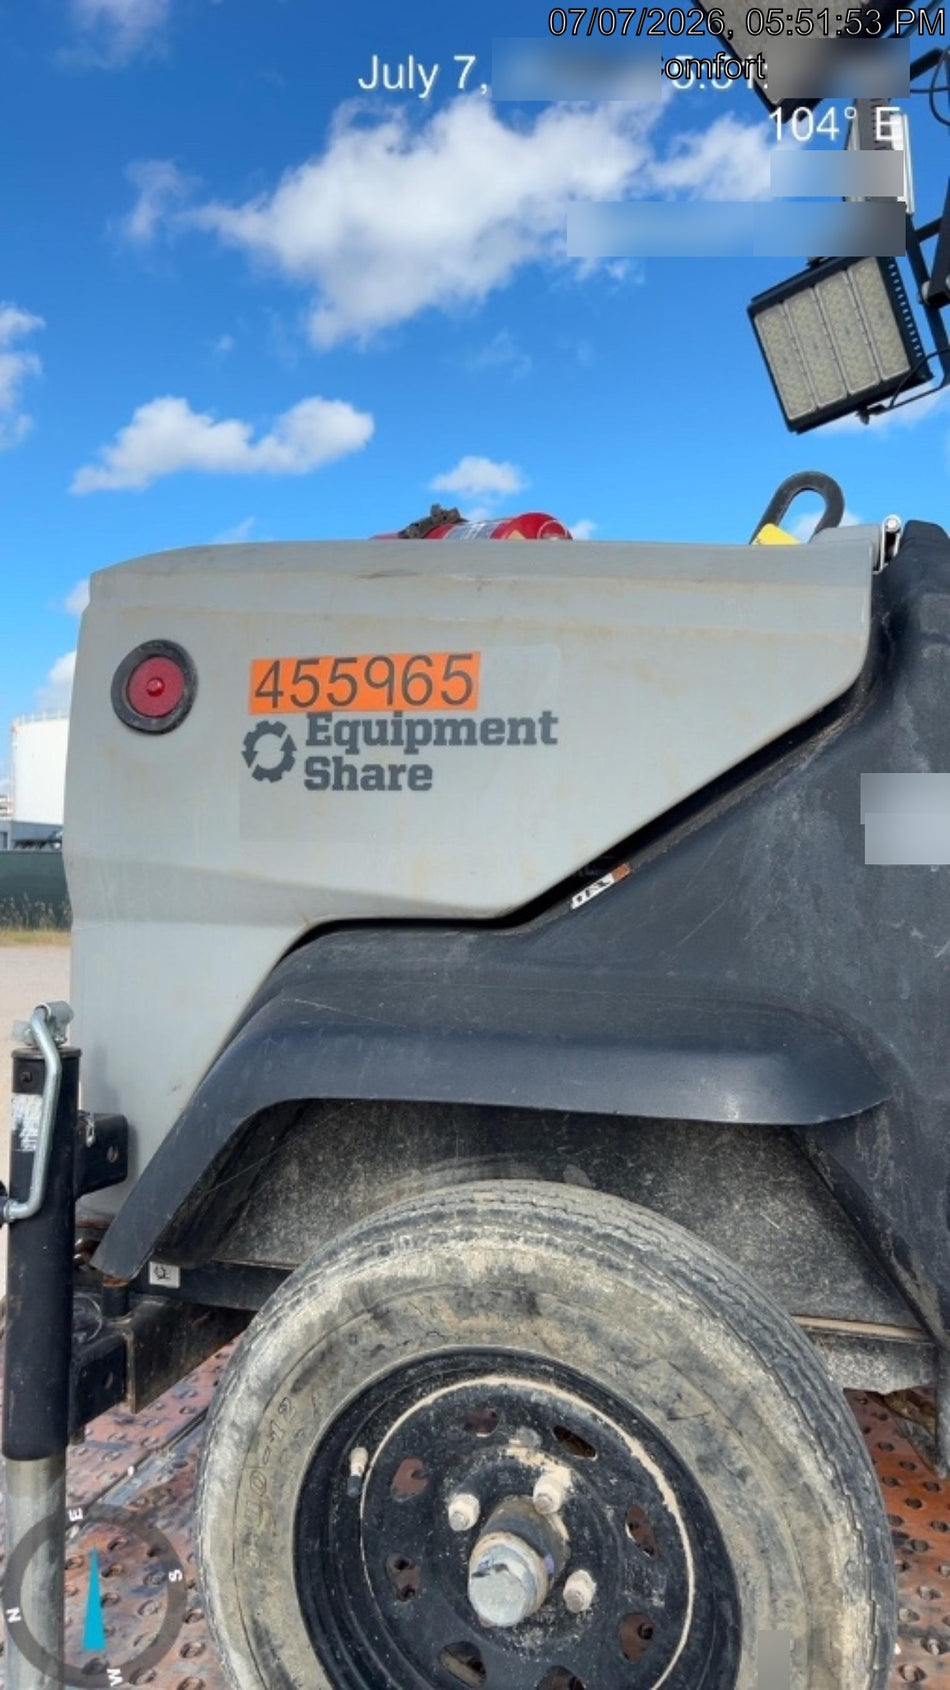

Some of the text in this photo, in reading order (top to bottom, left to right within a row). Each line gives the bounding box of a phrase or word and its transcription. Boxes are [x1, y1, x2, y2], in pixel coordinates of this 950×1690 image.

[254, 652, 473, 709] 455965
[305, 710, 559, 755] Equipment
[303, 755, 433, 792] Share
